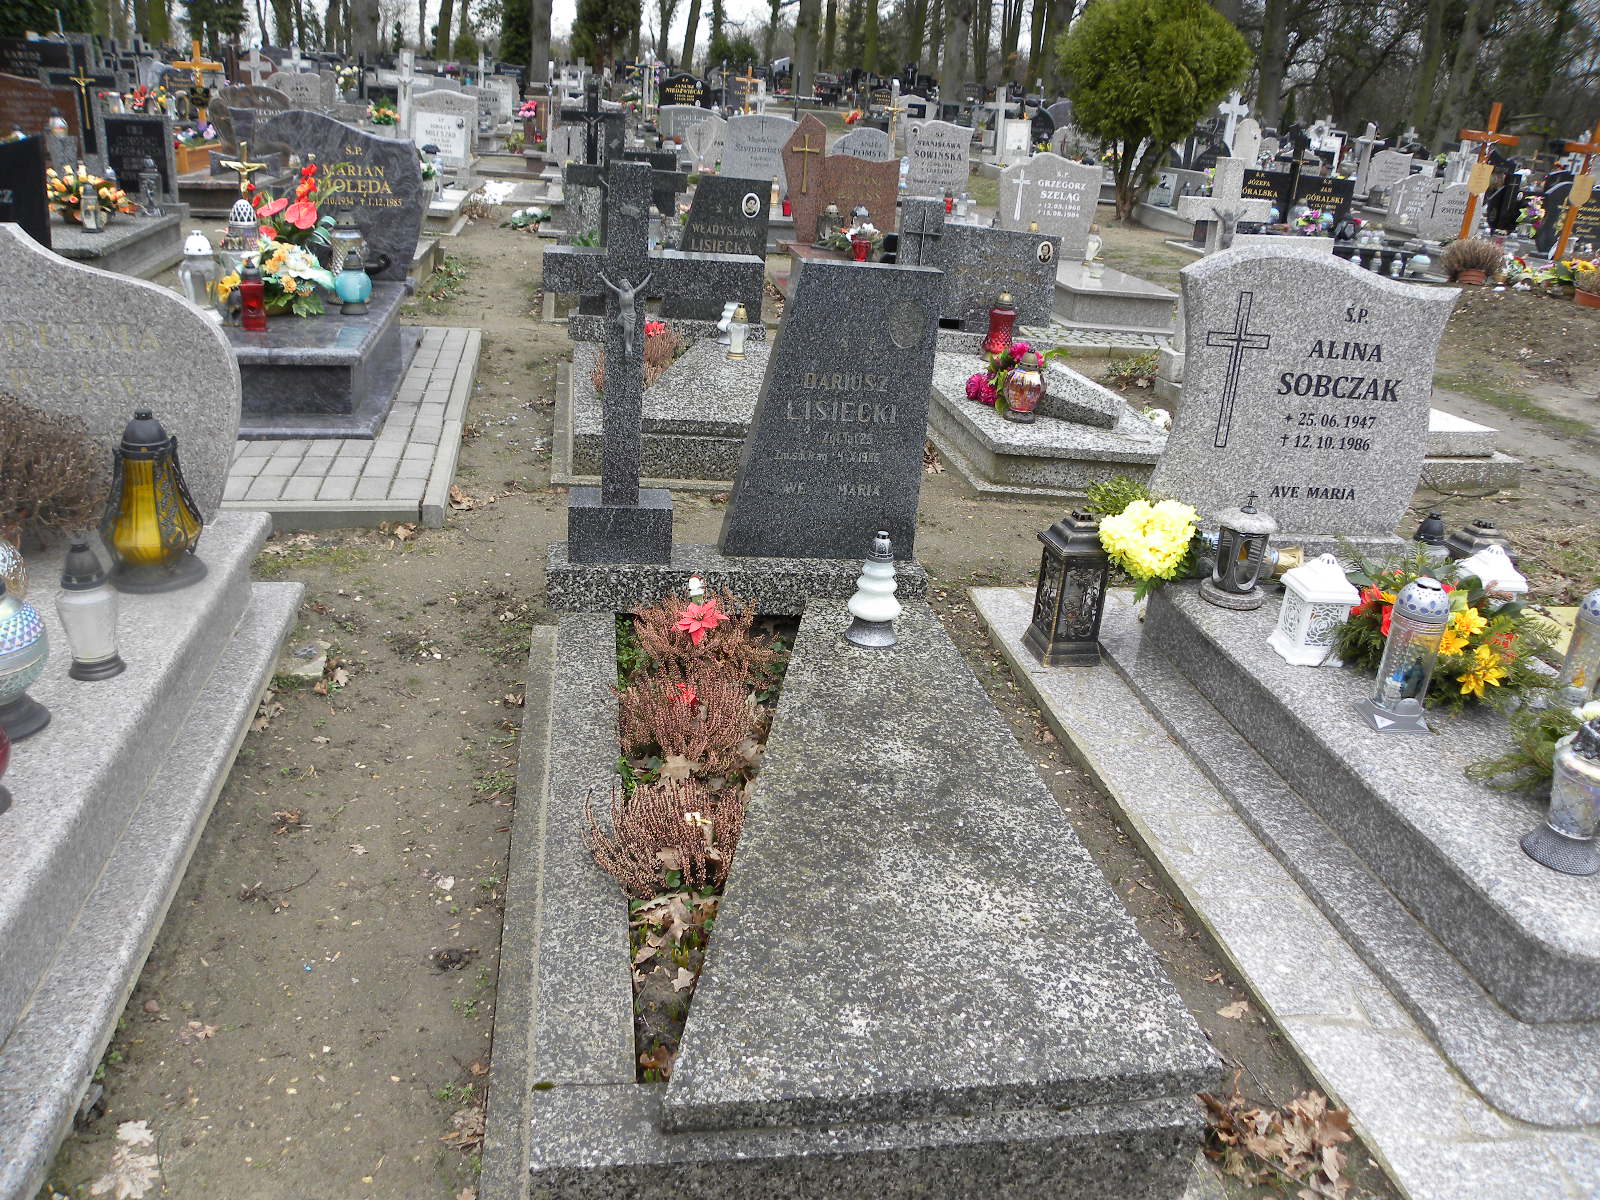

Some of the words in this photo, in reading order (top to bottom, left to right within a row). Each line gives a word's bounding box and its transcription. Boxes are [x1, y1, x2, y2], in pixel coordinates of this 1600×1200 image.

[322, 164, 385, 177] MARIAN
[1038, 179, 1087, 190] GRZEGORZ
[1242, 186, 1279, 198] ÓRALSKA
[1040, 190, 1081, 202] SZELĄG
[1305, 193, 1345, 204] GÓRALSKI
[692, 223, 757, 238] WŁADYSŁAWA
[690, 239, 753, 255] LISIECKA
[1344, 304, 1369, 325] Ś.P.
[1308, 339, 1383, 363] ALINA
[804, 372, 888, 392] DARIUSZ
[1277, 372, 1402, 402] SOBCZAK
[787, 399, 897, 425] LISIECKI
[1298, 412, 1377, 429] 25.06.1947
[1293, 435, 1371, 451] 12.10.1986
[837, 483, 880, 497] MARIA
[1269, 485, 1300, 499] AVE
[1306, 486, 1356, 501] MARIA
